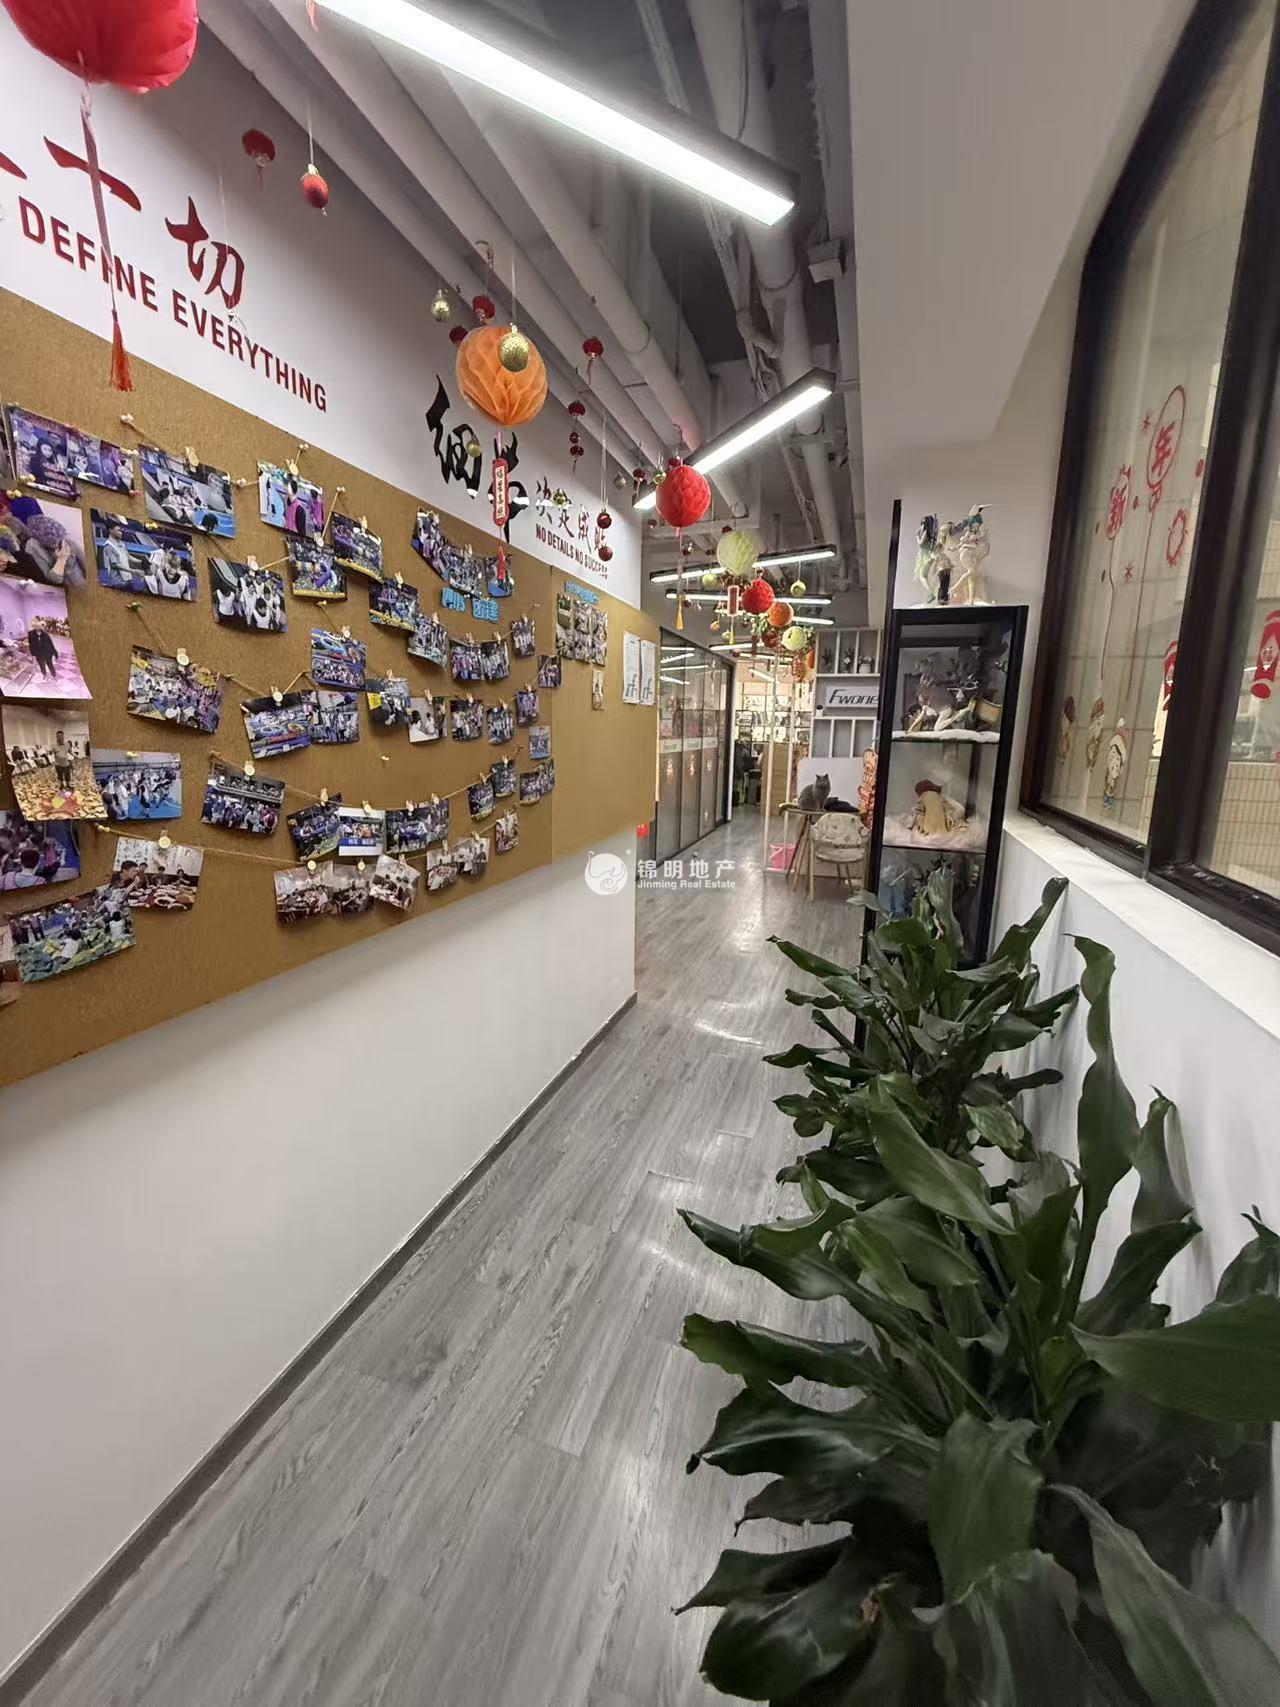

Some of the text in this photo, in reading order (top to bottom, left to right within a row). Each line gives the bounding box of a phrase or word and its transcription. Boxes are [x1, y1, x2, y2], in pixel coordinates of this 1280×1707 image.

[0, 135, 245, 309] 一切
[18, 196, 328, 413] DEFINE EVERYTHING
[536, 523, 547, 543] NO
[547, 530, 574, 559] DETAILS
[575, 547, 584, 565] NO
